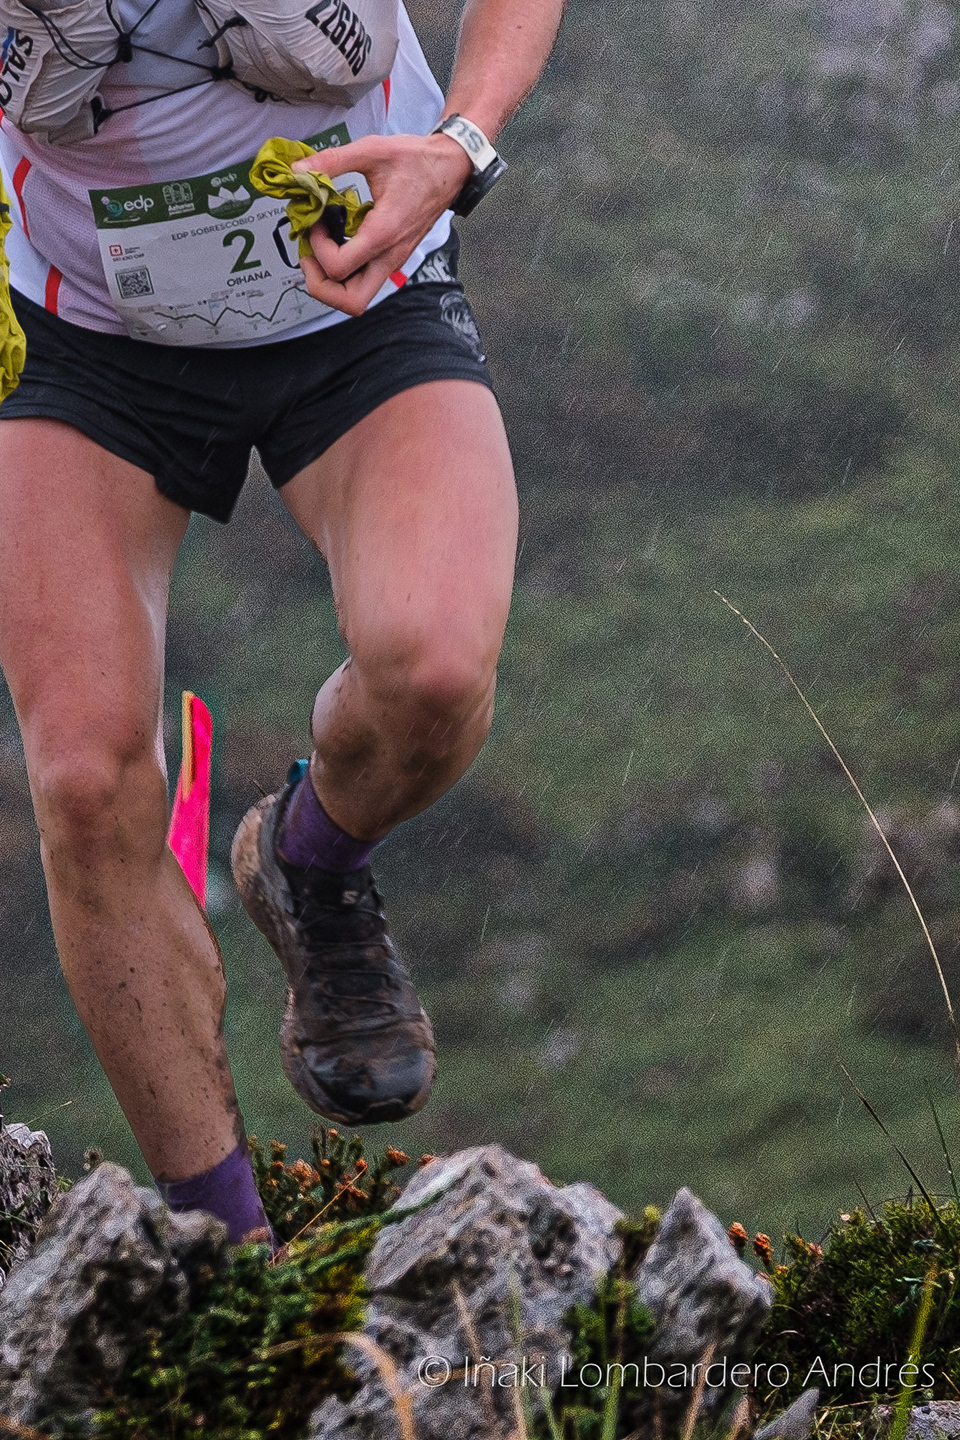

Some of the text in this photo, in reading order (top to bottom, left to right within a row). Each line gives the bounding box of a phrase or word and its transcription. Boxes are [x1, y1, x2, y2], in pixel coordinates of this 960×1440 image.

[123, 194, 155, 212] edp
[171, 230, 189, 241] EDP
[190, 215, 255, 237] SOBRESCOBIO
[226, 270, 272, 288] OIHANA
